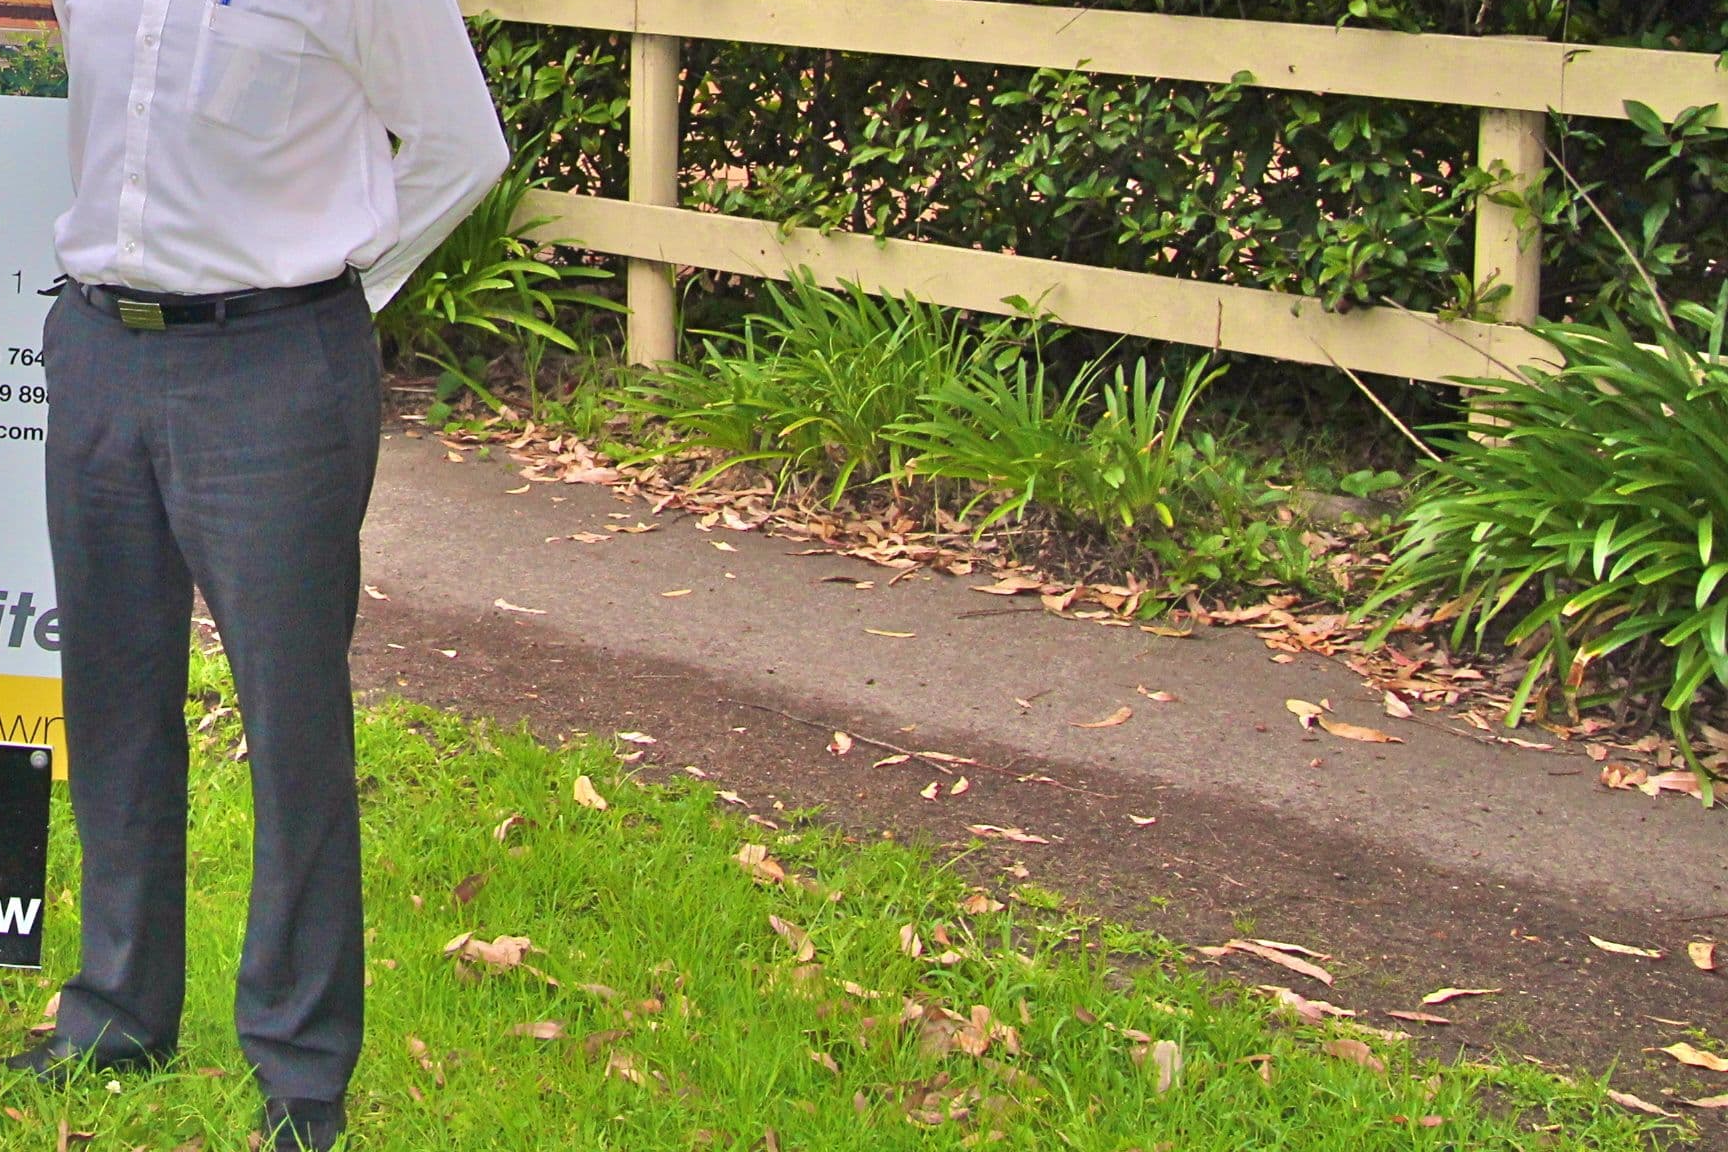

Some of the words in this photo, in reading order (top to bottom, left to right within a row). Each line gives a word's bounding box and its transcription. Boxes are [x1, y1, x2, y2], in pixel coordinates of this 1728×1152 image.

[11, 270, 22, 294] 1
[8, 348, 44, 367] 764
[19, 386, 50, 405] 89
